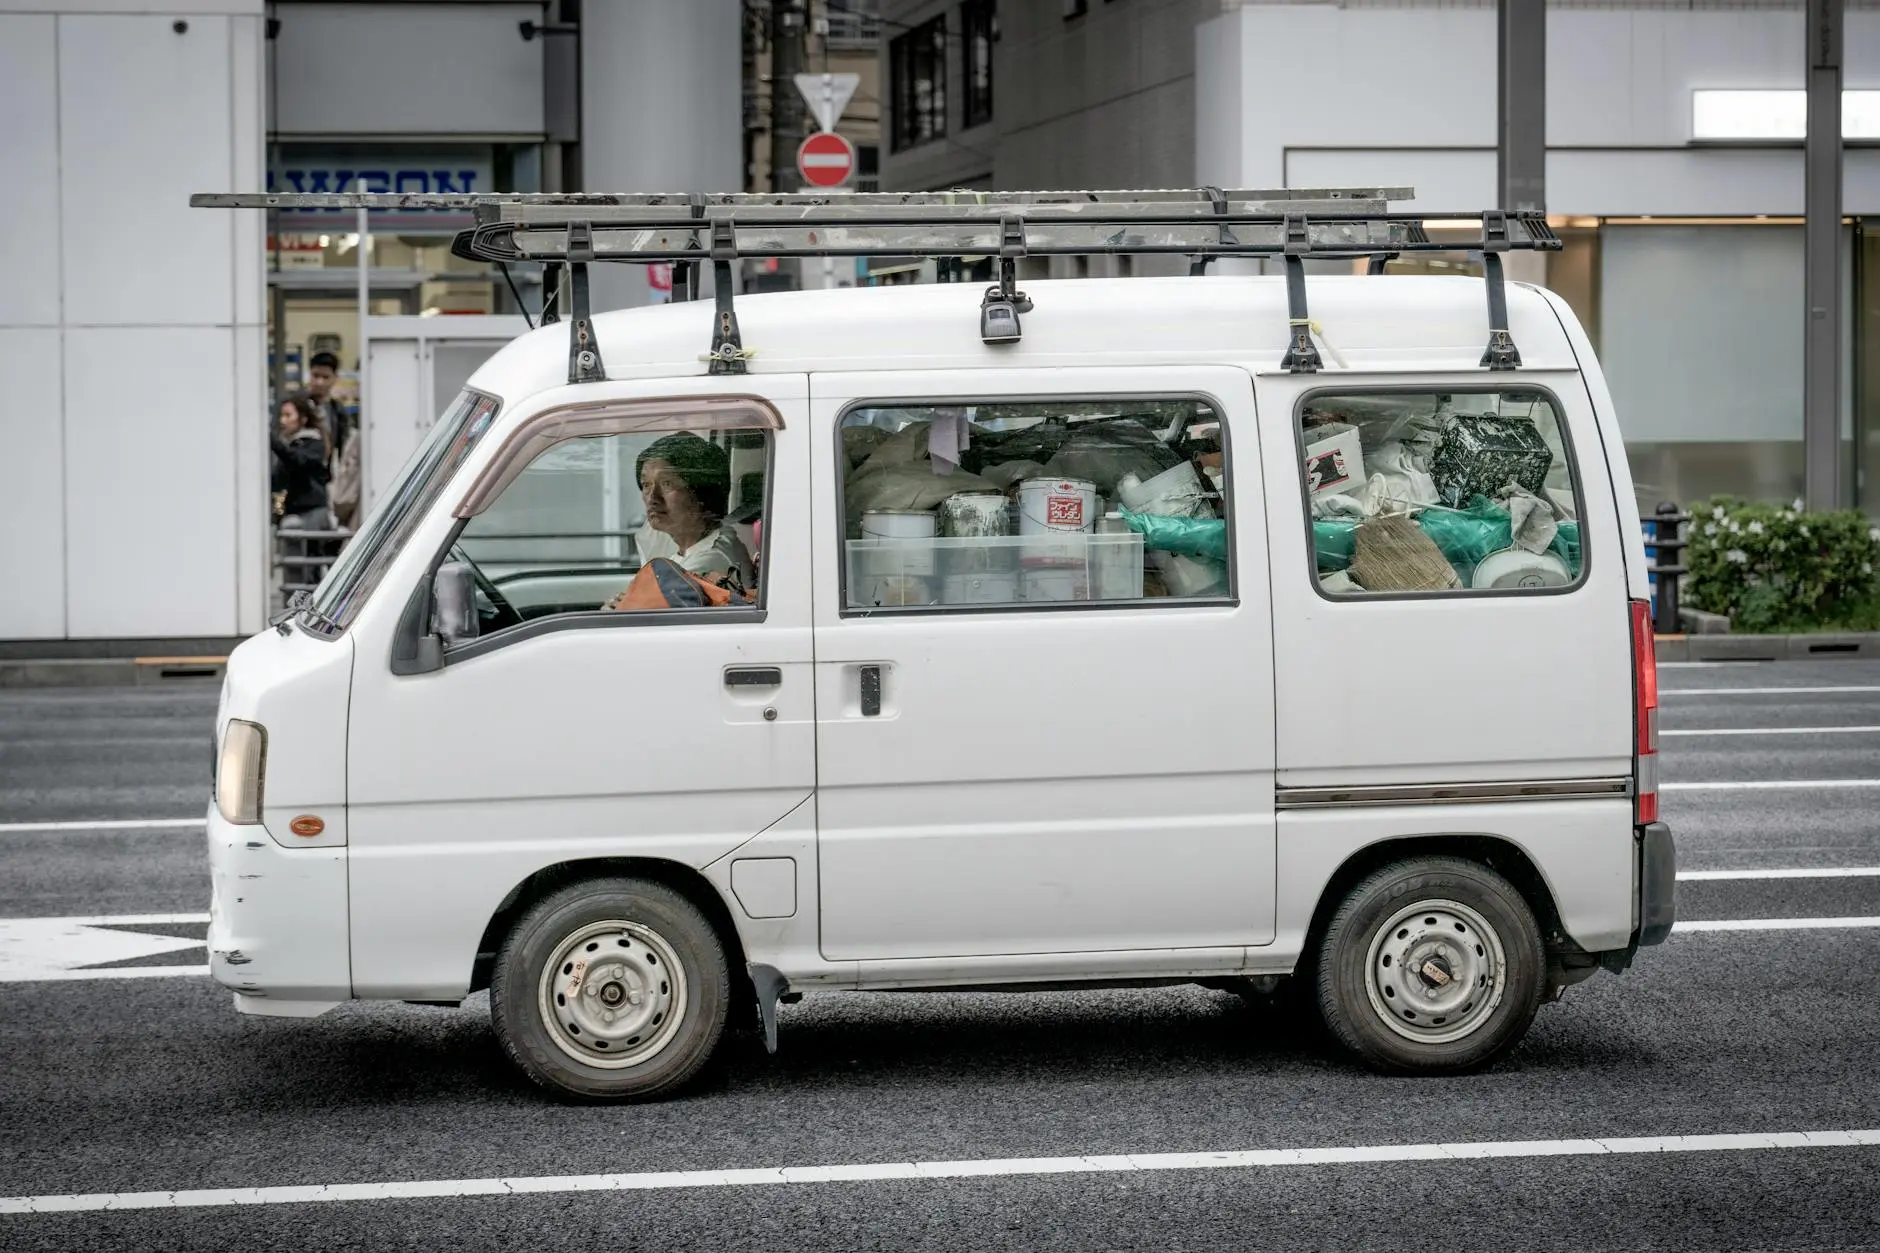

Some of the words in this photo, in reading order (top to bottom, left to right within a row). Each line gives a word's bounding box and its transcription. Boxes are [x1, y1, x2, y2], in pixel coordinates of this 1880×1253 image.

[267, 170, 477, 211] WSON
[1049, 501, 1078, 511] ファイン
[1051, 510, 1081, 520] ウレタン
